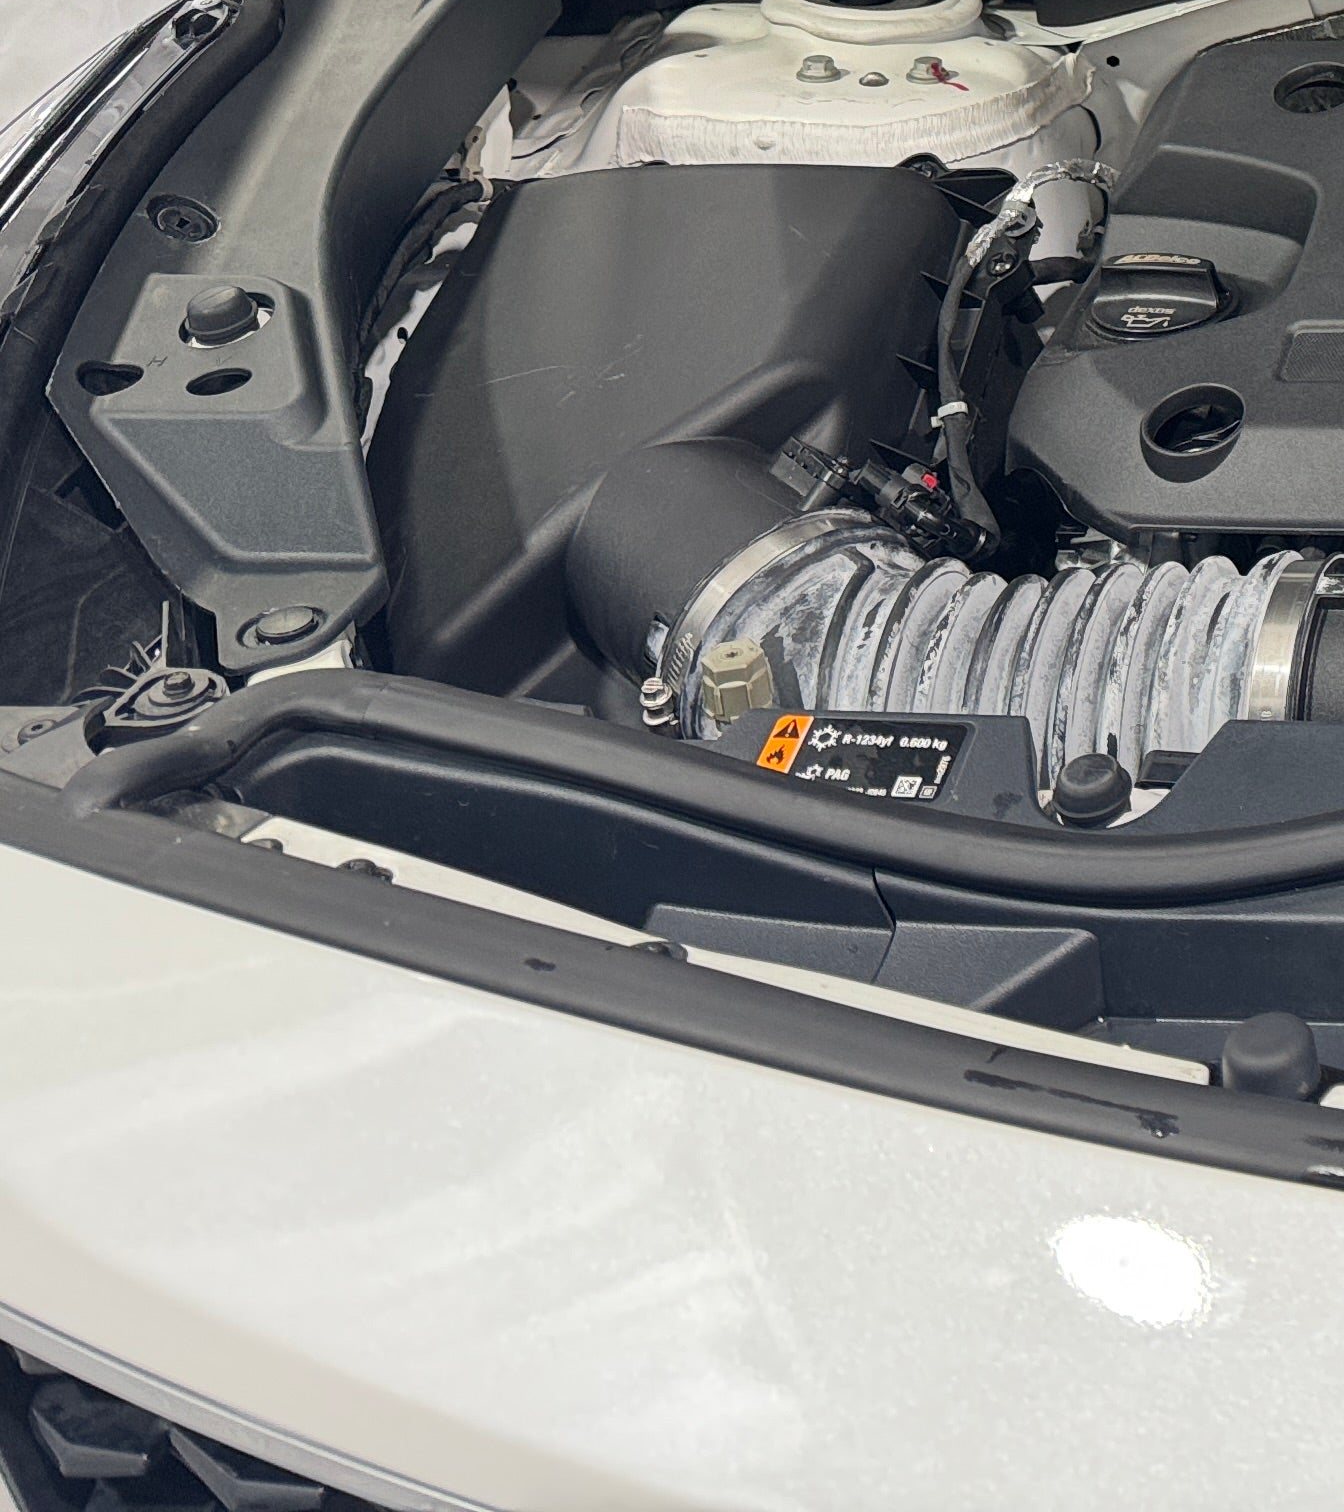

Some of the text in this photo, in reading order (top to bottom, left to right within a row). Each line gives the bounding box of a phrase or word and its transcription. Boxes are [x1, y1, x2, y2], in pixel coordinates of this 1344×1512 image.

[1128, 306, 1176, 314] dexos
[843, 734, 894, 748] R-1234yf
[932, 739, 948, 751] kg
[825, 769, 850, 781] PAG
